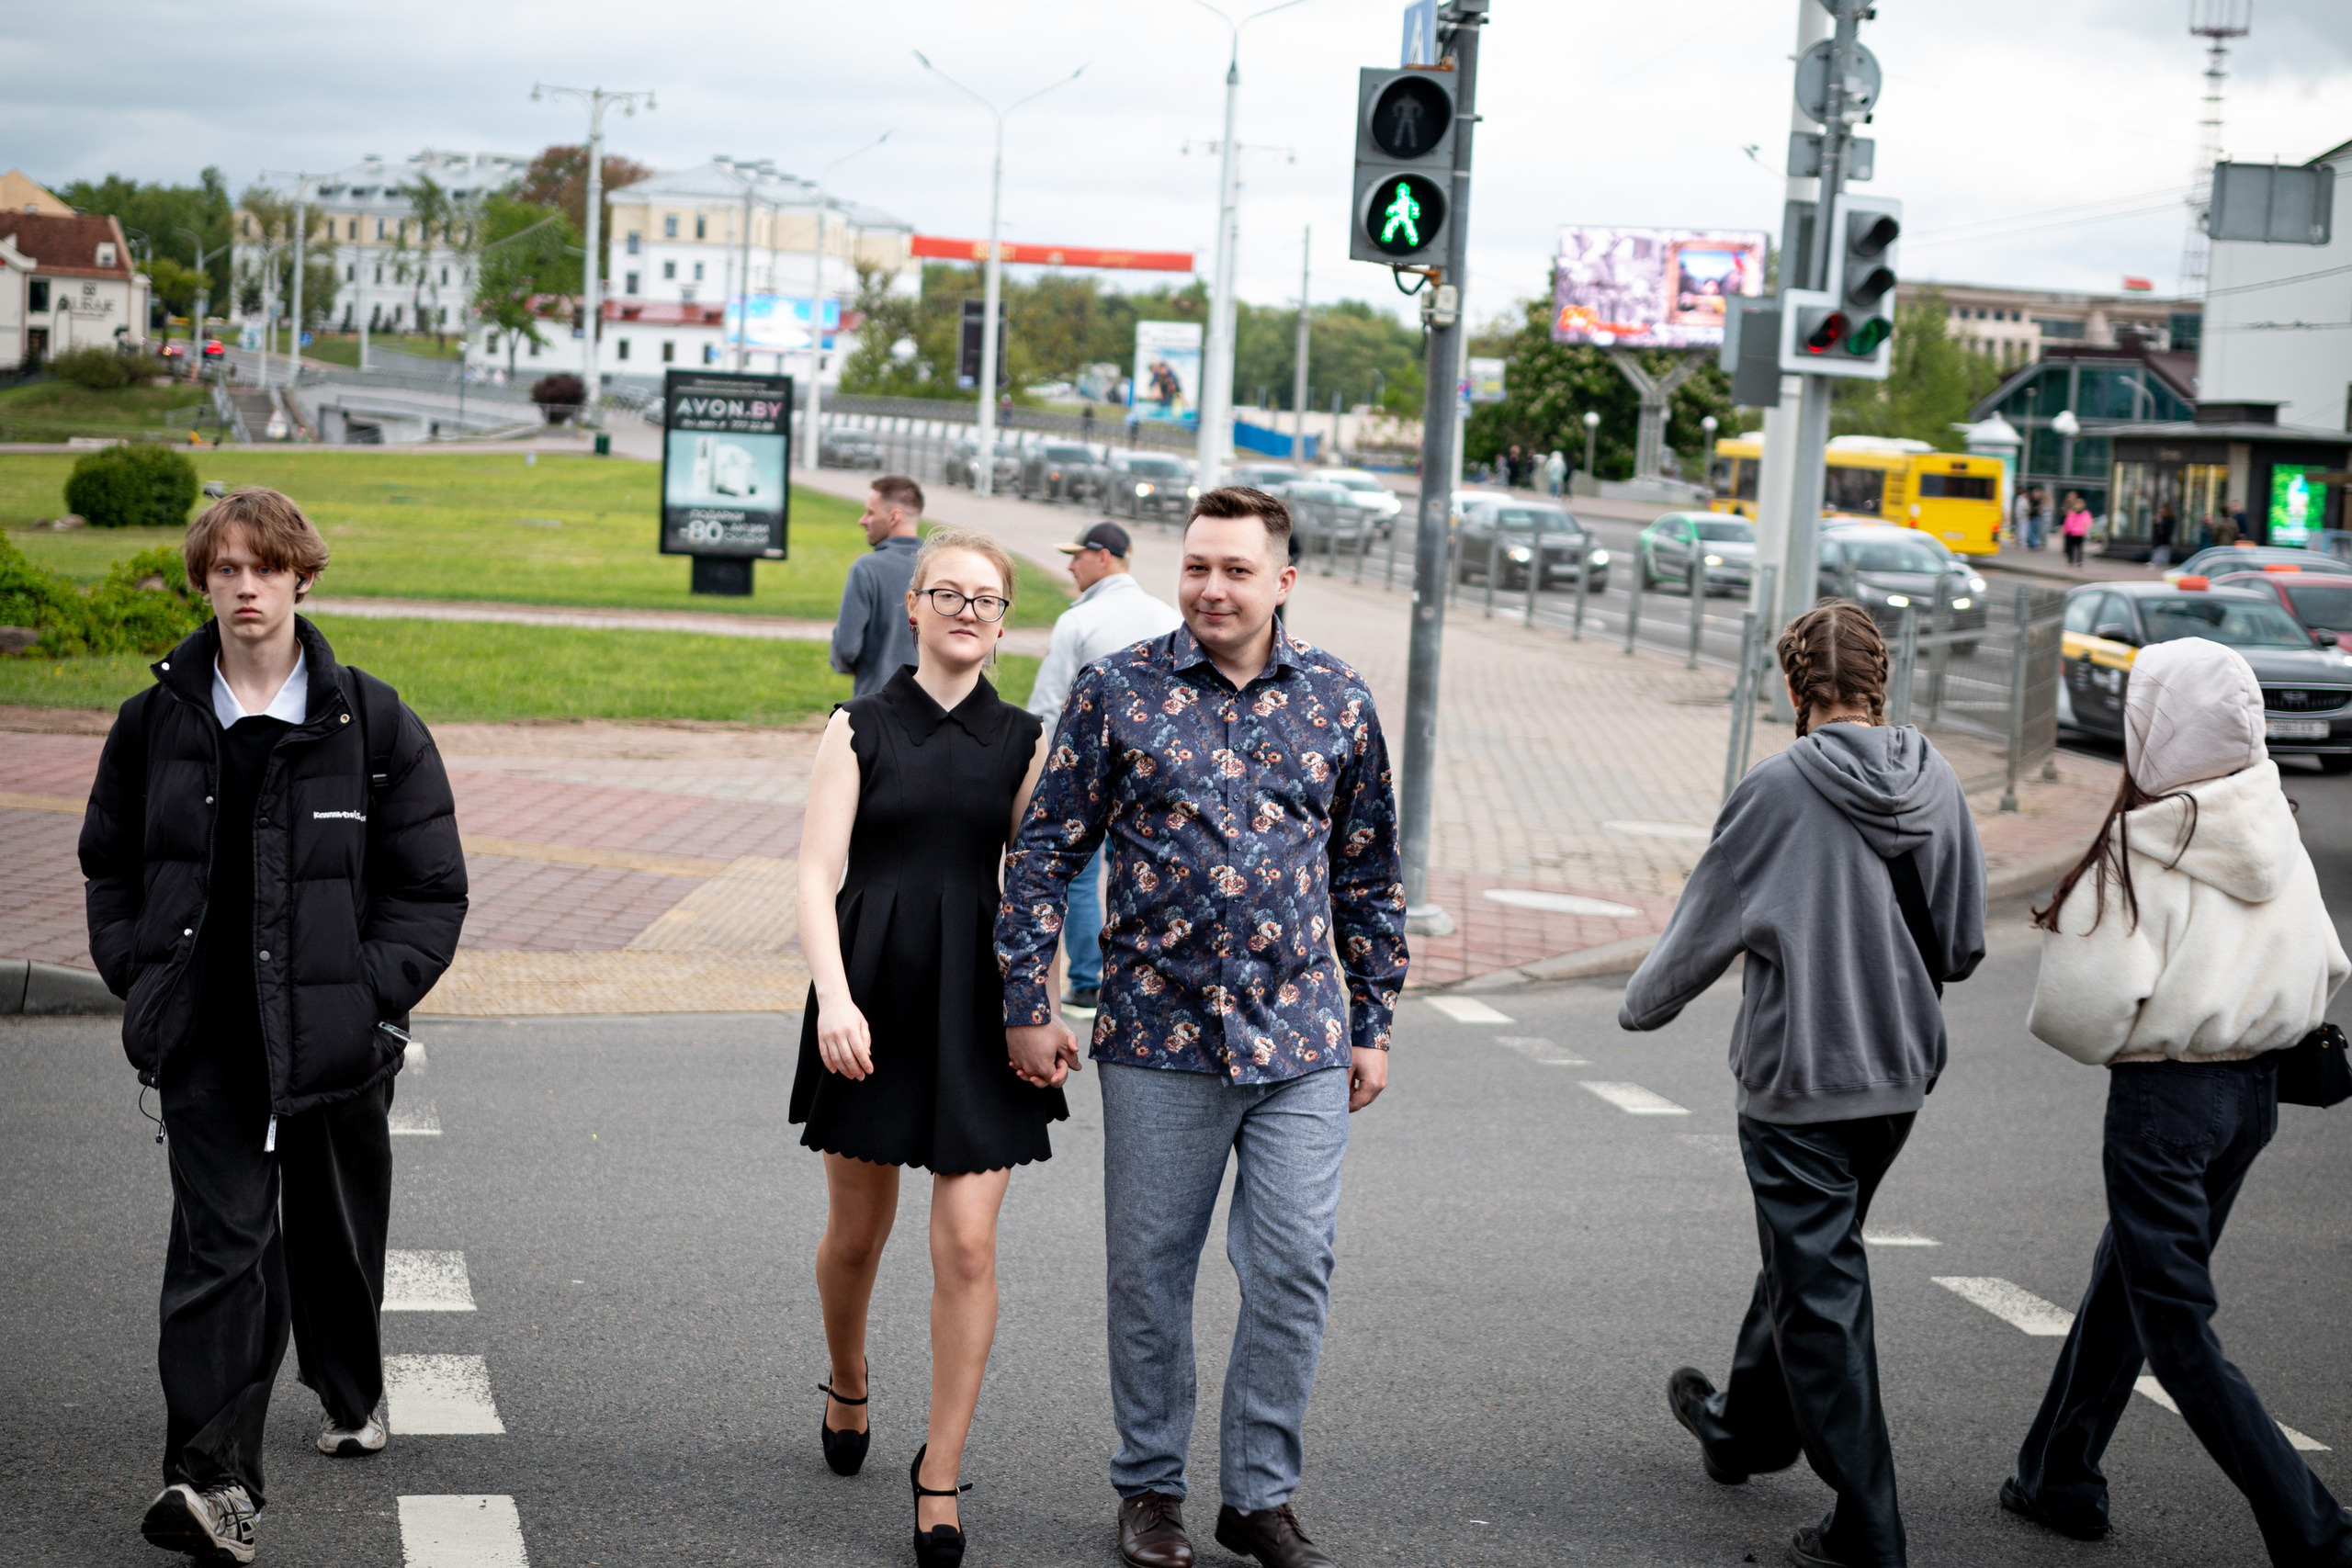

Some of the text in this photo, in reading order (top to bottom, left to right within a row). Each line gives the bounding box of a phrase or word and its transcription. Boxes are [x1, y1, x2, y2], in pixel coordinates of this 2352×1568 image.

[676, 398, 782, 419] AVON.BY
[690, 510, 745, 523] ПОДАРКИ
[680, 521, 723, 544] -80
